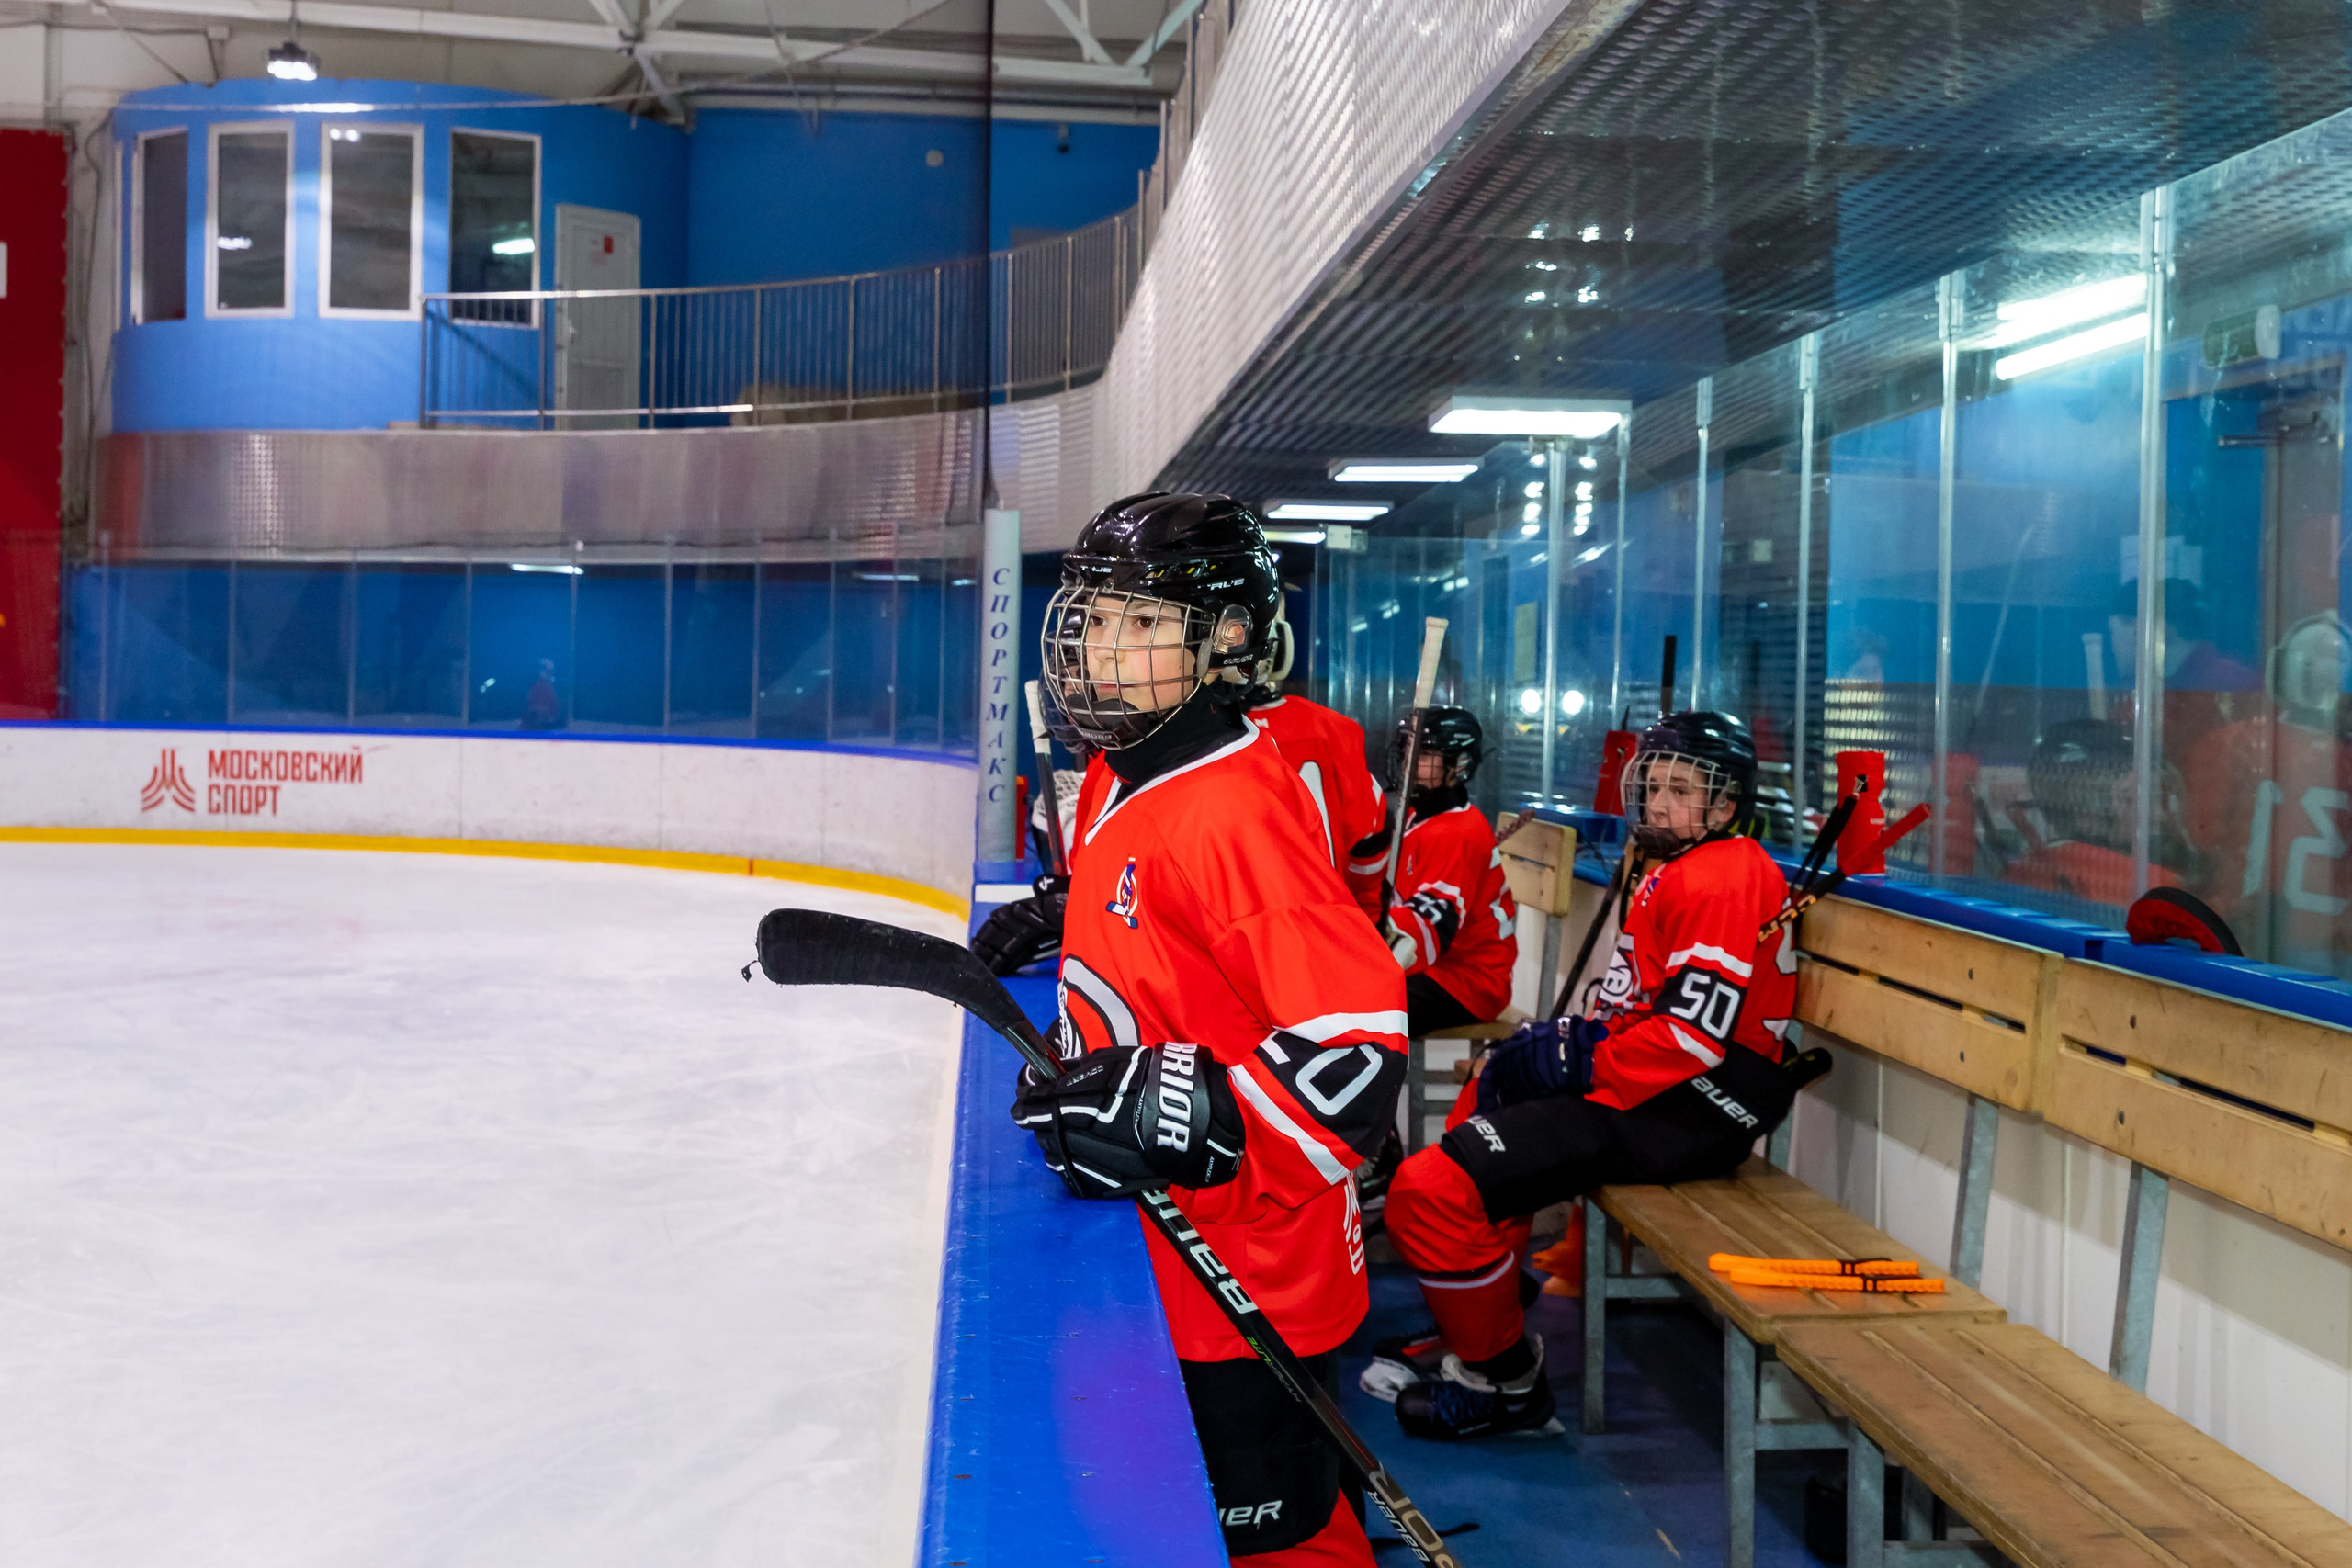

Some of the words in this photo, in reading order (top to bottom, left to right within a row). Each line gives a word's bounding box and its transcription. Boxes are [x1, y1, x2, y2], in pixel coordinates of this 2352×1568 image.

[987, 567, 1010, 803] СПОРТМАКС
[208, 745, 363, 784] МОСКОВСКИЙ
[208, 784, 280, 816] СПОРТ
[1670, 971, 1740, 1040] 50
[1367, 1491, 1430, 1562] BAUER
